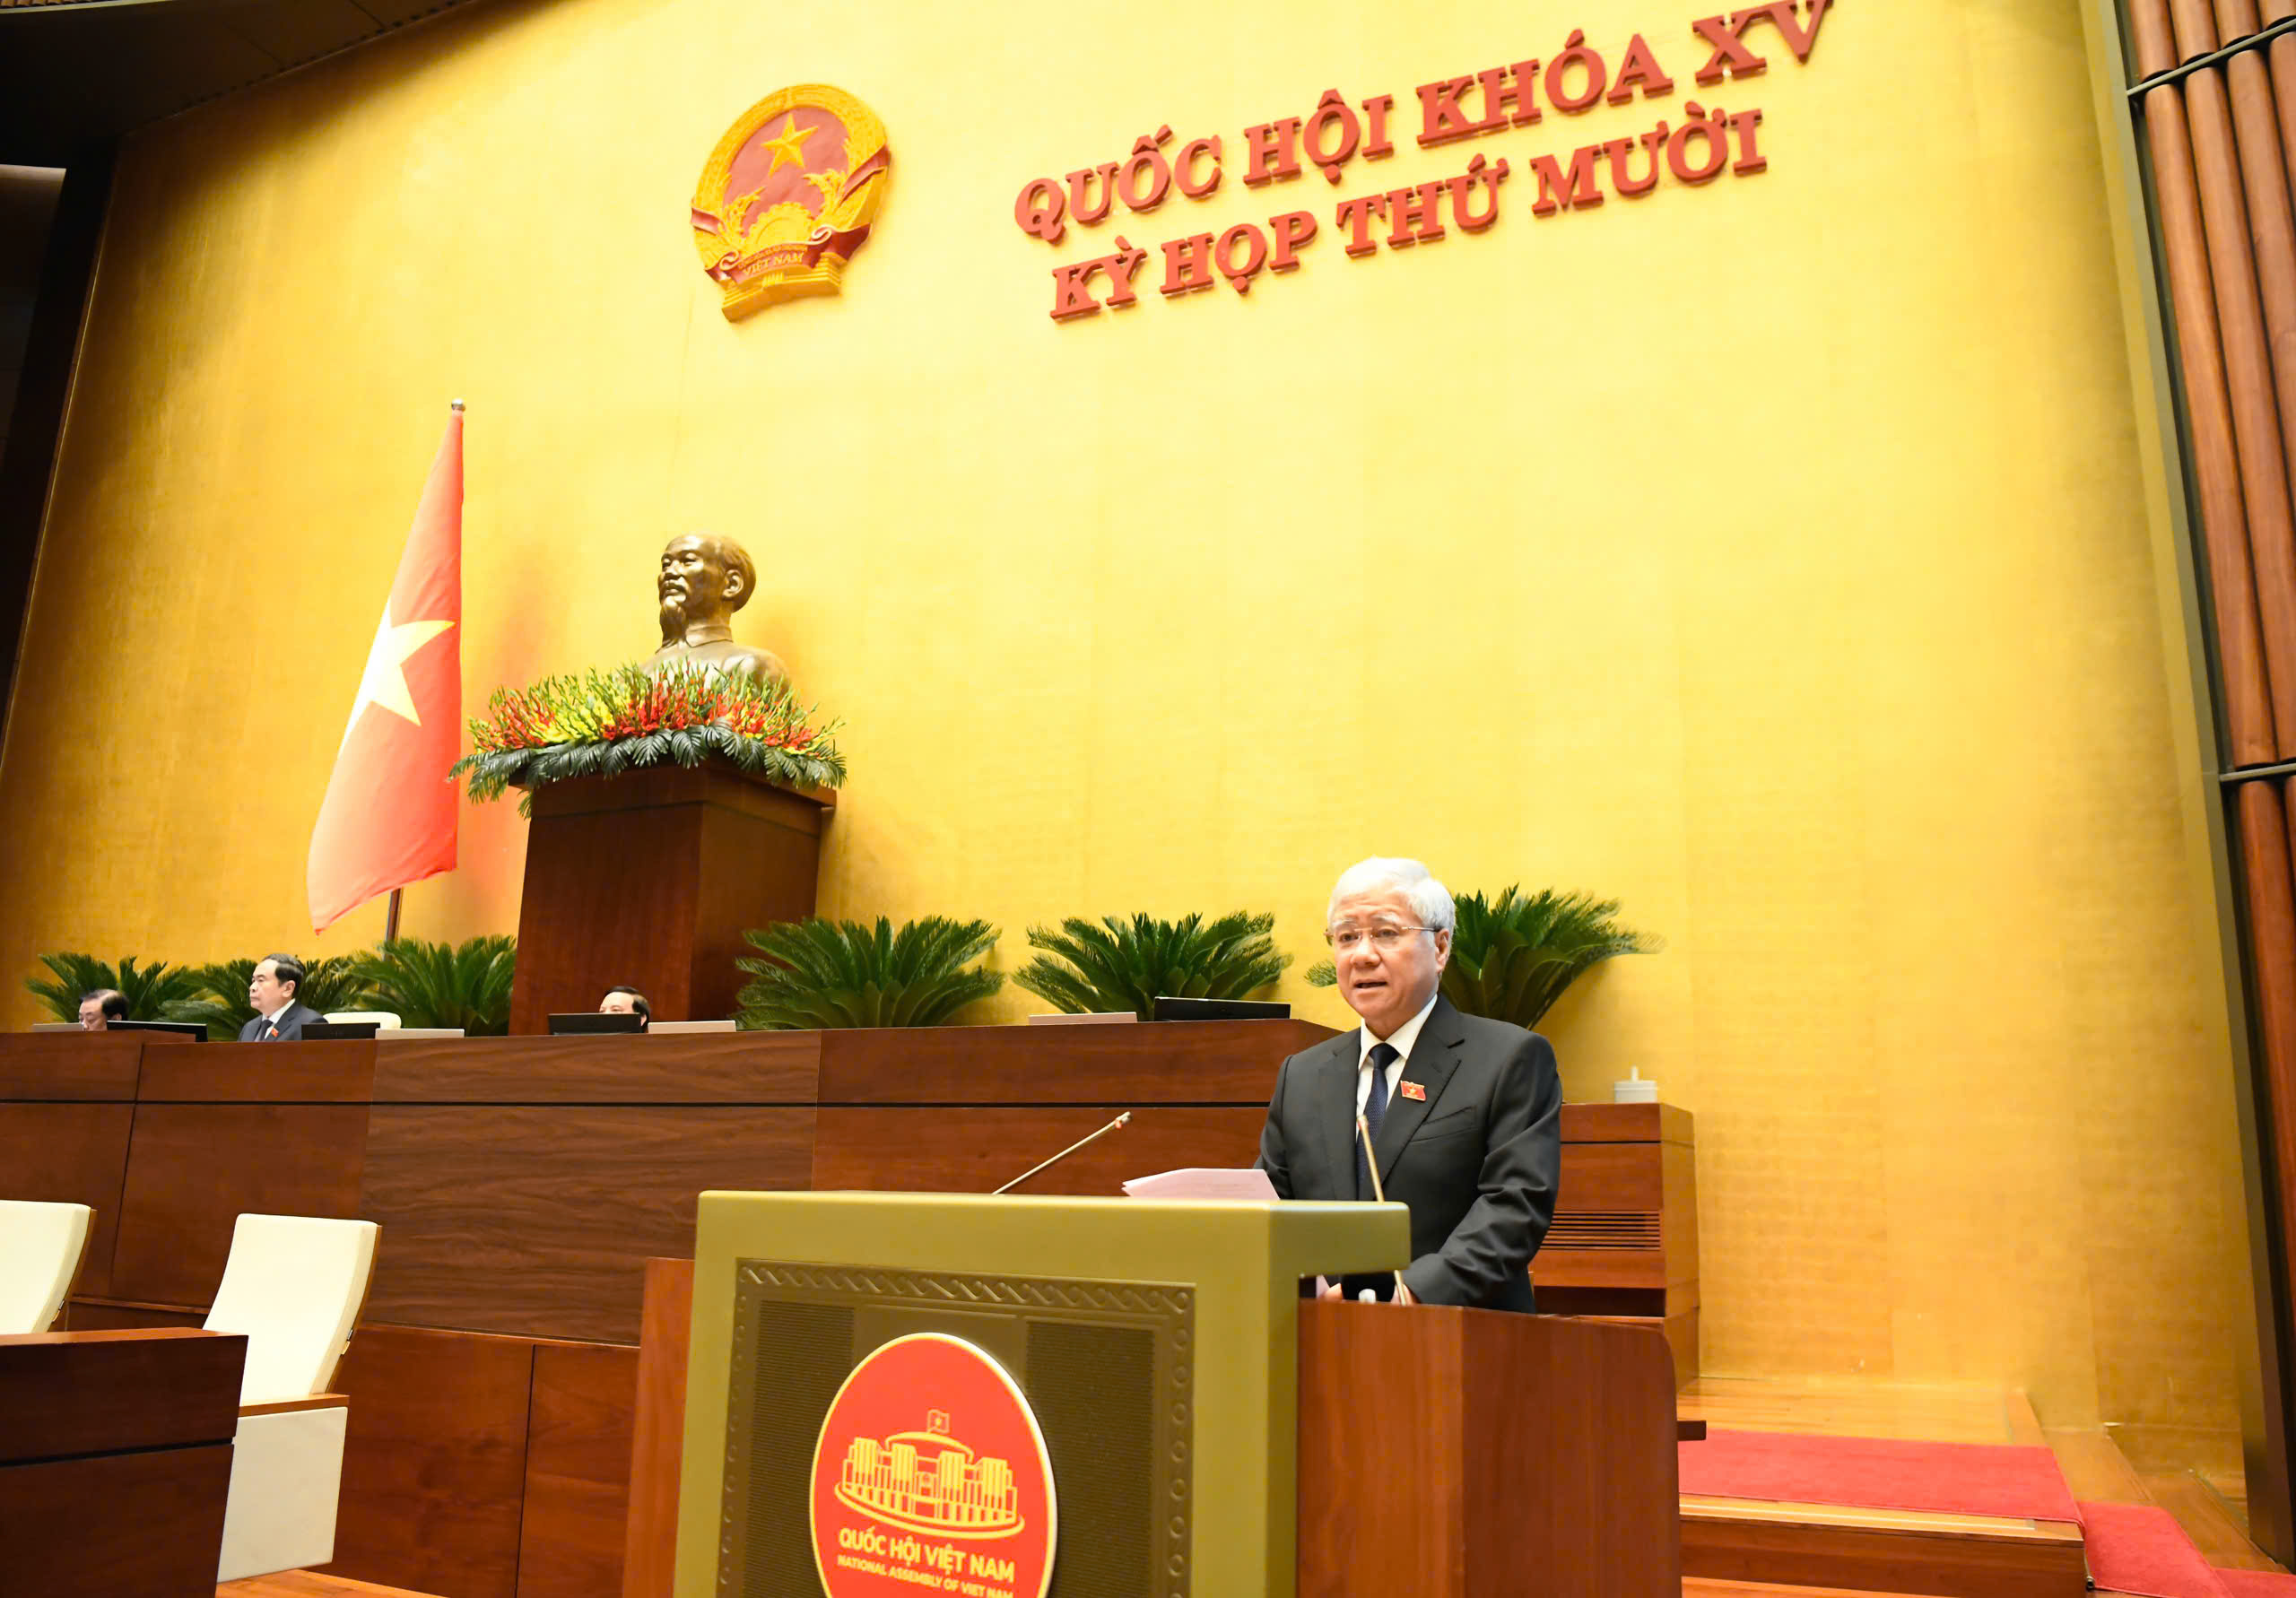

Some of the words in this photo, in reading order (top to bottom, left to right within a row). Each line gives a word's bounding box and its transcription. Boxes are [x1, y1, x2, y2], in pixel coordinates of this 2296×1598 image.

[1014, 125, 1222, 245] QUỐC
[1243, 88, 1395, 185] HỘI
[1415, 29, 1674, 147] KHÓA
[1692, 0, 1834, 83] XV
[1050, 236, 1148, 321] KỲ
[1160, 211, 1318, 294] HỌP
[1336, 153, 1509, 256] THỨ
[1530, 100, 1767, 216] MƯỜI
[774, 252, 804, 267] NAM
[838, 1554, 887, 1576] NATIONAL
[889, 1566, 942, 1587] ASSEMBLY
[944, 1577, 960, 1592] OF
[839, 1525, 886, 1555] QUỐC
[890, 1535, 921, 1567] HỘI
[925, 1543, 966, 1576] VIỆT
[970, 1553, 1015, 1584] NAM
